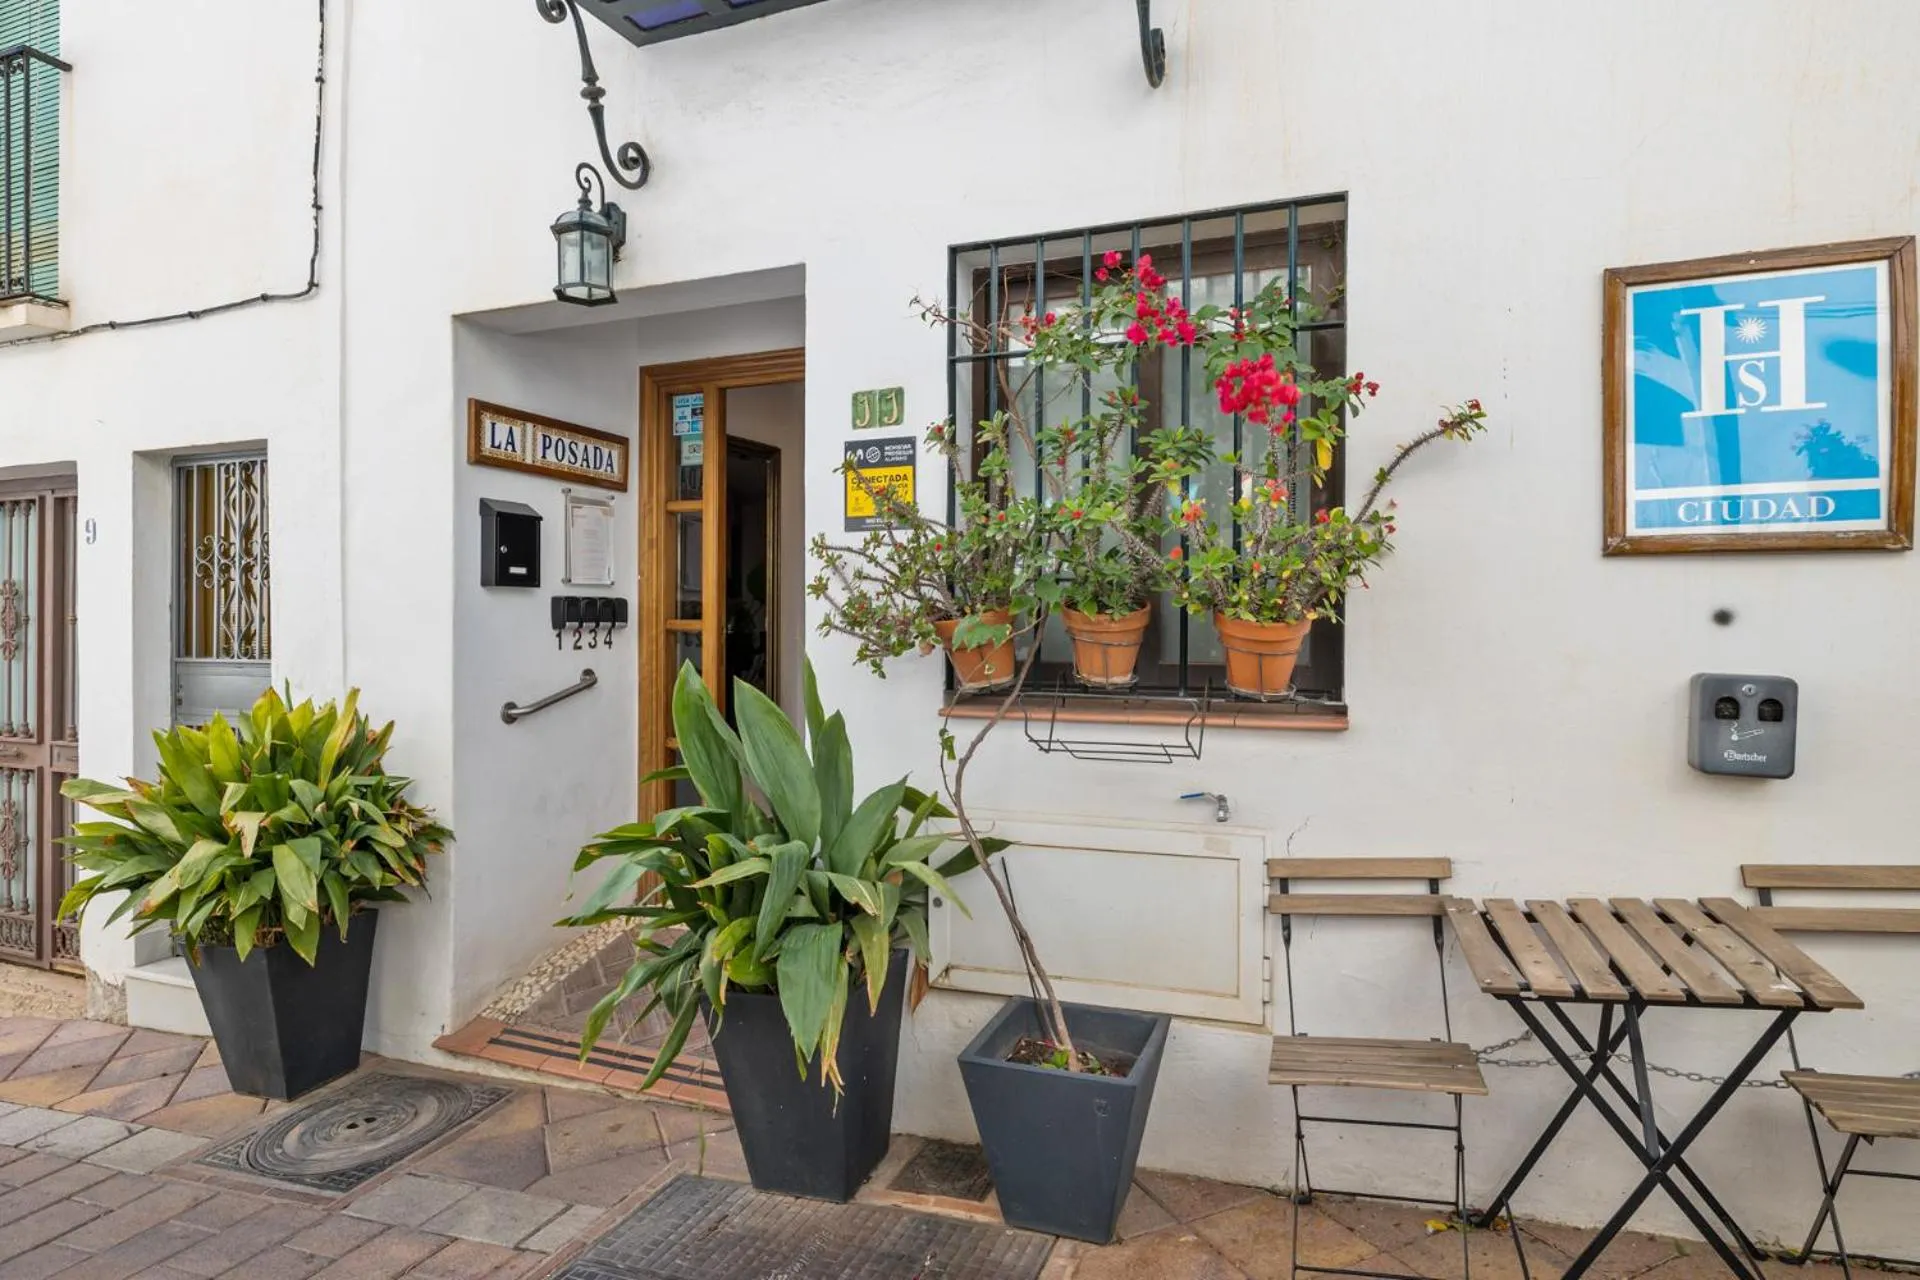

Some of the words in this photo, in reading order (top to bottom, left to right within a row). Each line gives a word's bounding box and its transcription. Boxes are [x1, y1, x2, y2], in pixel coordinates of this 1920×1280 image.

[490, 422, 516, 453] LA
[541, 433, 615, 473] POSADA
[1678, 496, 1835, 523] CIUDAD
[85, 518, 97, 545] 9
